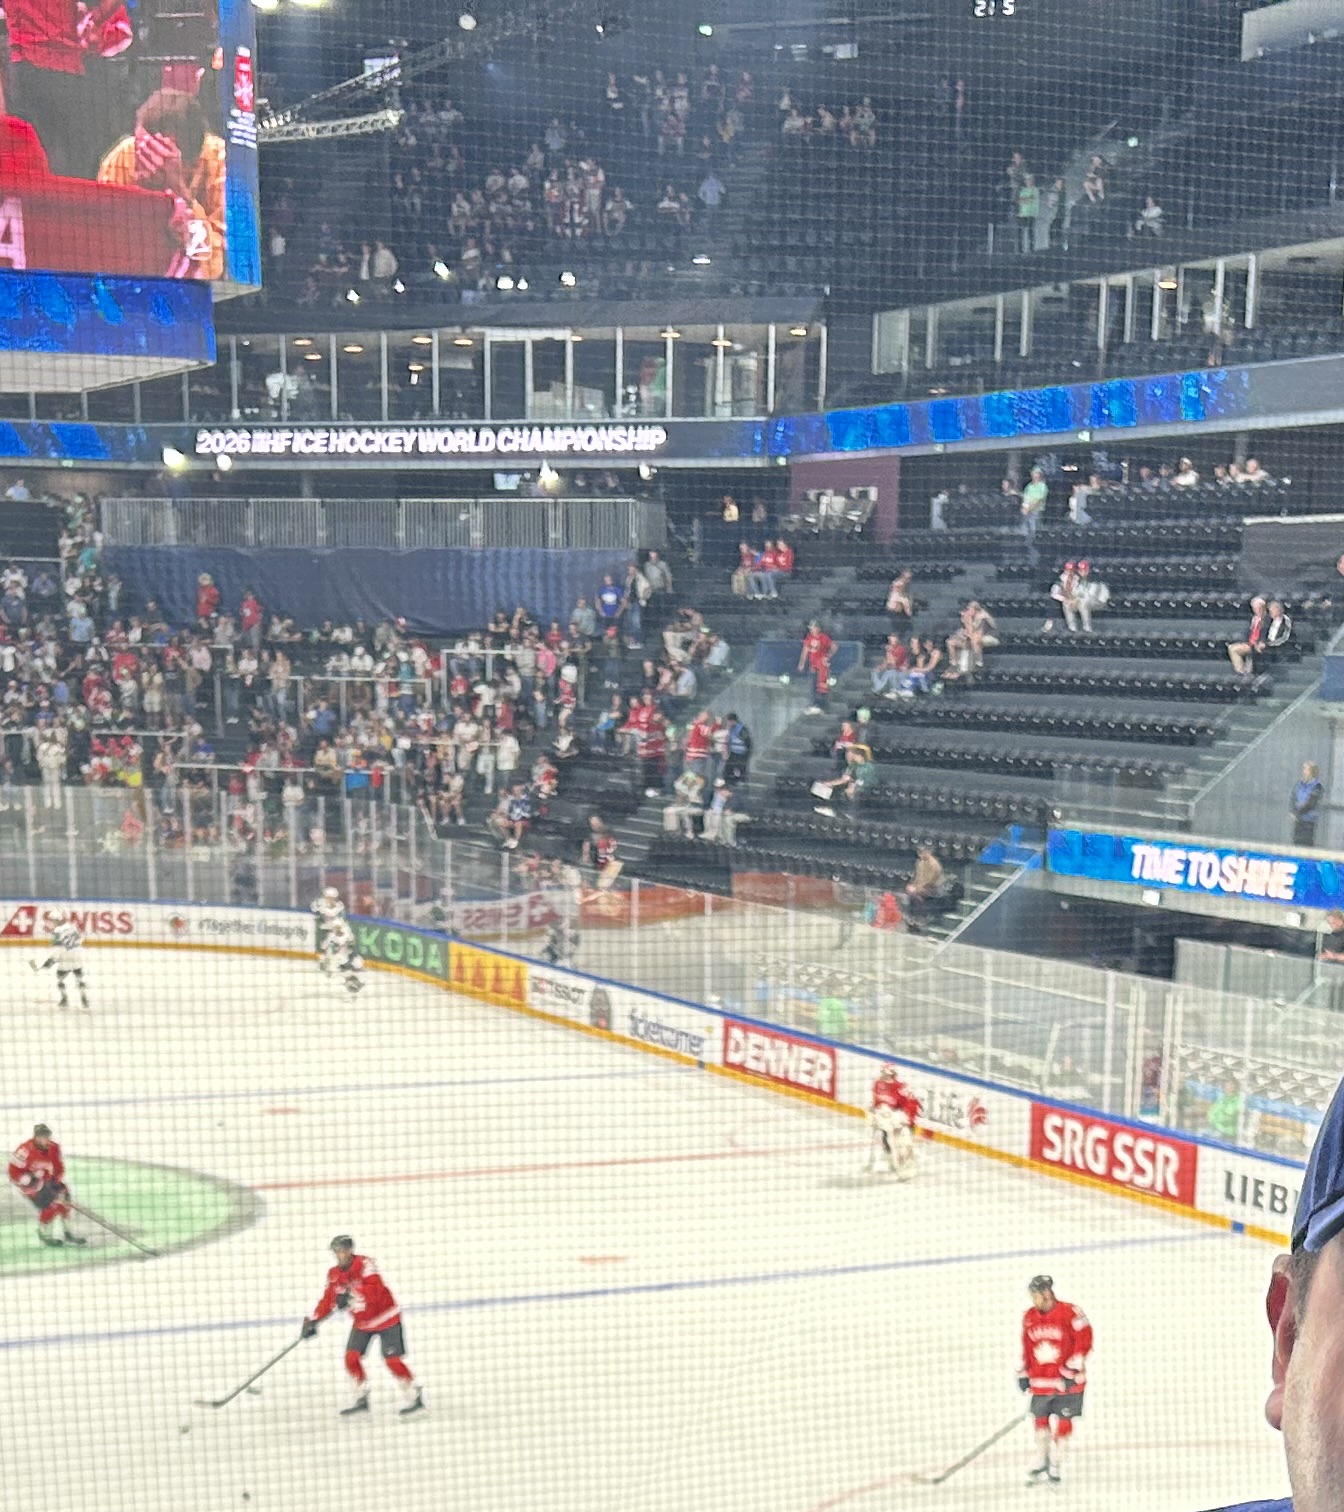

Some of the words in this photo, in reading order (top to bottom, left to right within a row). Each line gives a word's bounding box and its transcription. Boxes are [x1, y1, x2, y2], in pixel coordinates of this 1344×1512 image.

[195, 429, 251, 454] 2026
[293, 429, 329, 453] ICE
[329, 429, 417, 453] HOCKEY
[417, 428, 496, 453] WORLD
[497, 426, 668, 452] CHAMPIONSHIP
[1131, 844, 1187, 885] TIME
[1186, 852, 1220, 889] TO
[1218, 855, 1299, 900] SHINE
[359, 926, 444, 974] KODA
[727, 1023, 833, 1094] DENNER
[1042, 1114, 1108, 1176] SRG
[1111, 1131, 1179, 1197] SSR
